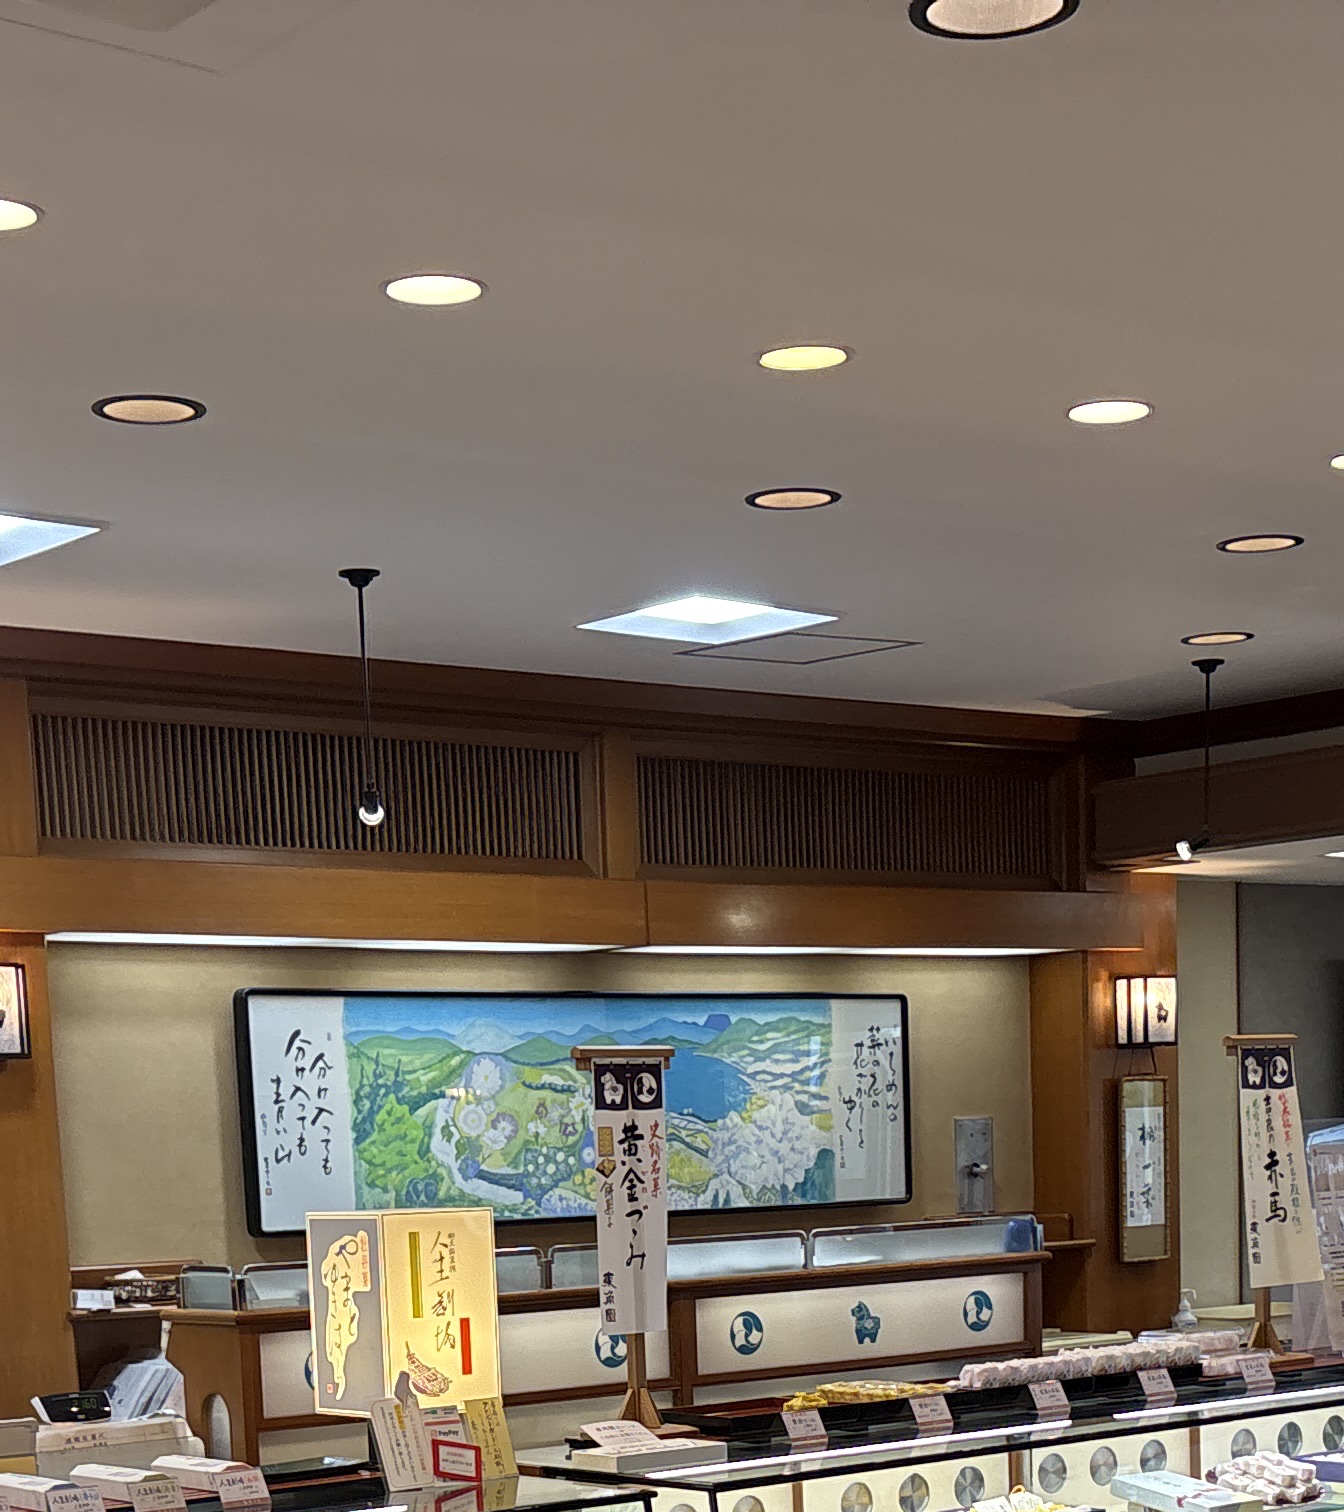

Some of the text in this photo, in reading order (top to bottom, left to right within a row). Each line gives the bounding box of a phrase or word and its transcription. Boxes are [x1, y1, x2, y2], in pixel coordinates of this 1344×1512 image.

[285, 1029, 312, 1156] 分け入っても
[309, 1052, 334, 1175] 分け入っても
